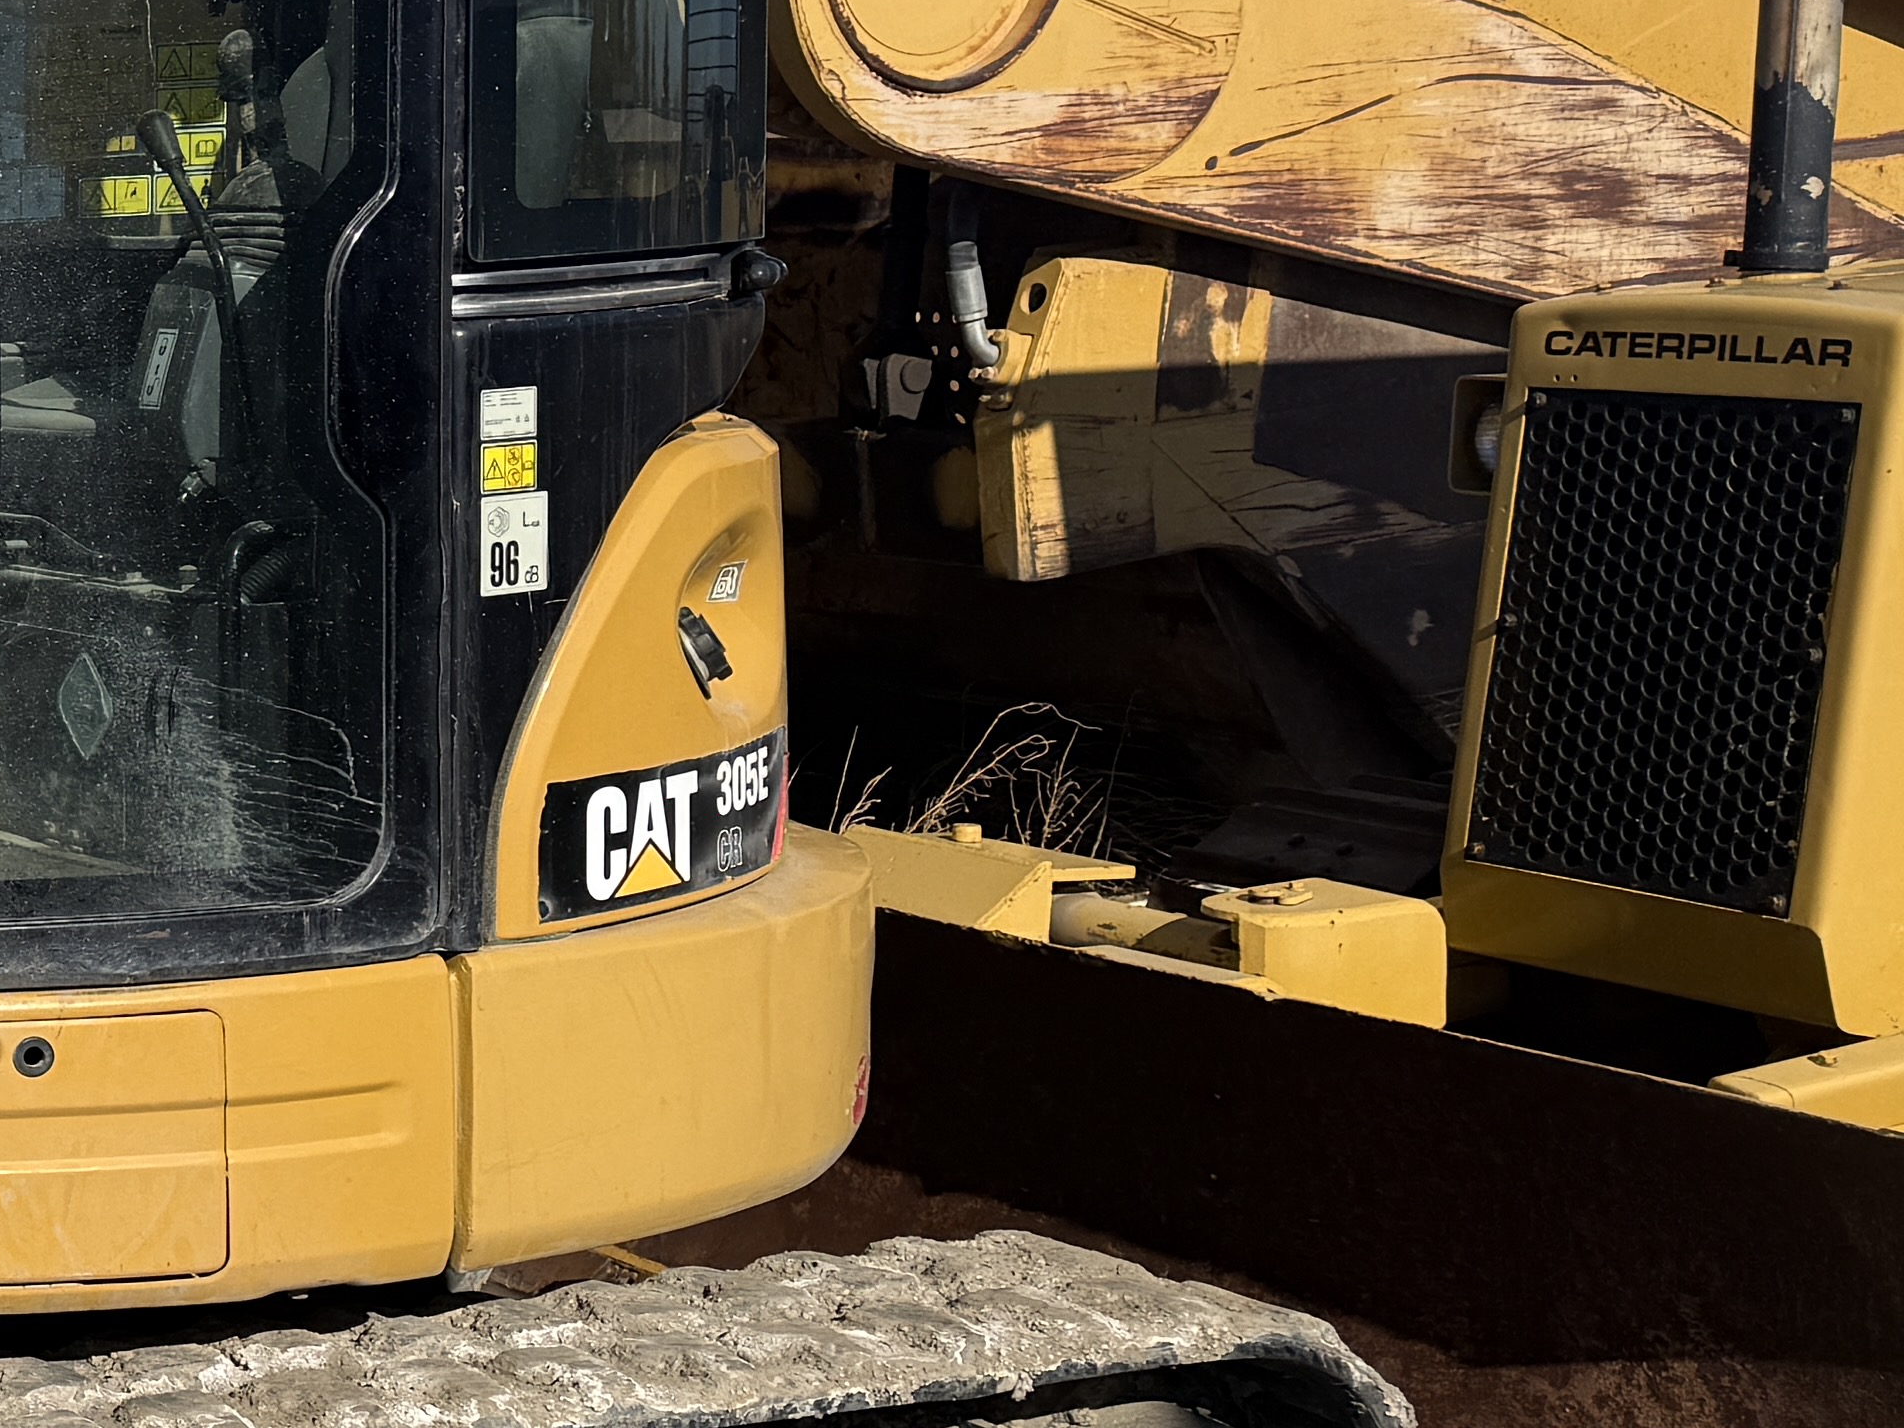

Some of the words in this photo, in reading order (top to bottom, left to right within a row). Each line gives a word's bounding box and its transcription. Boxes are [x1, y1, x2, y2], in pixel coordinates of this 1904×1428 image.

[1544, 330, 1853, 368] CATERPILLAR
[490, 540, 519, 587] 96
[716, 745, 769, 816] 305E
[586, 770, 699, 901] CAT
